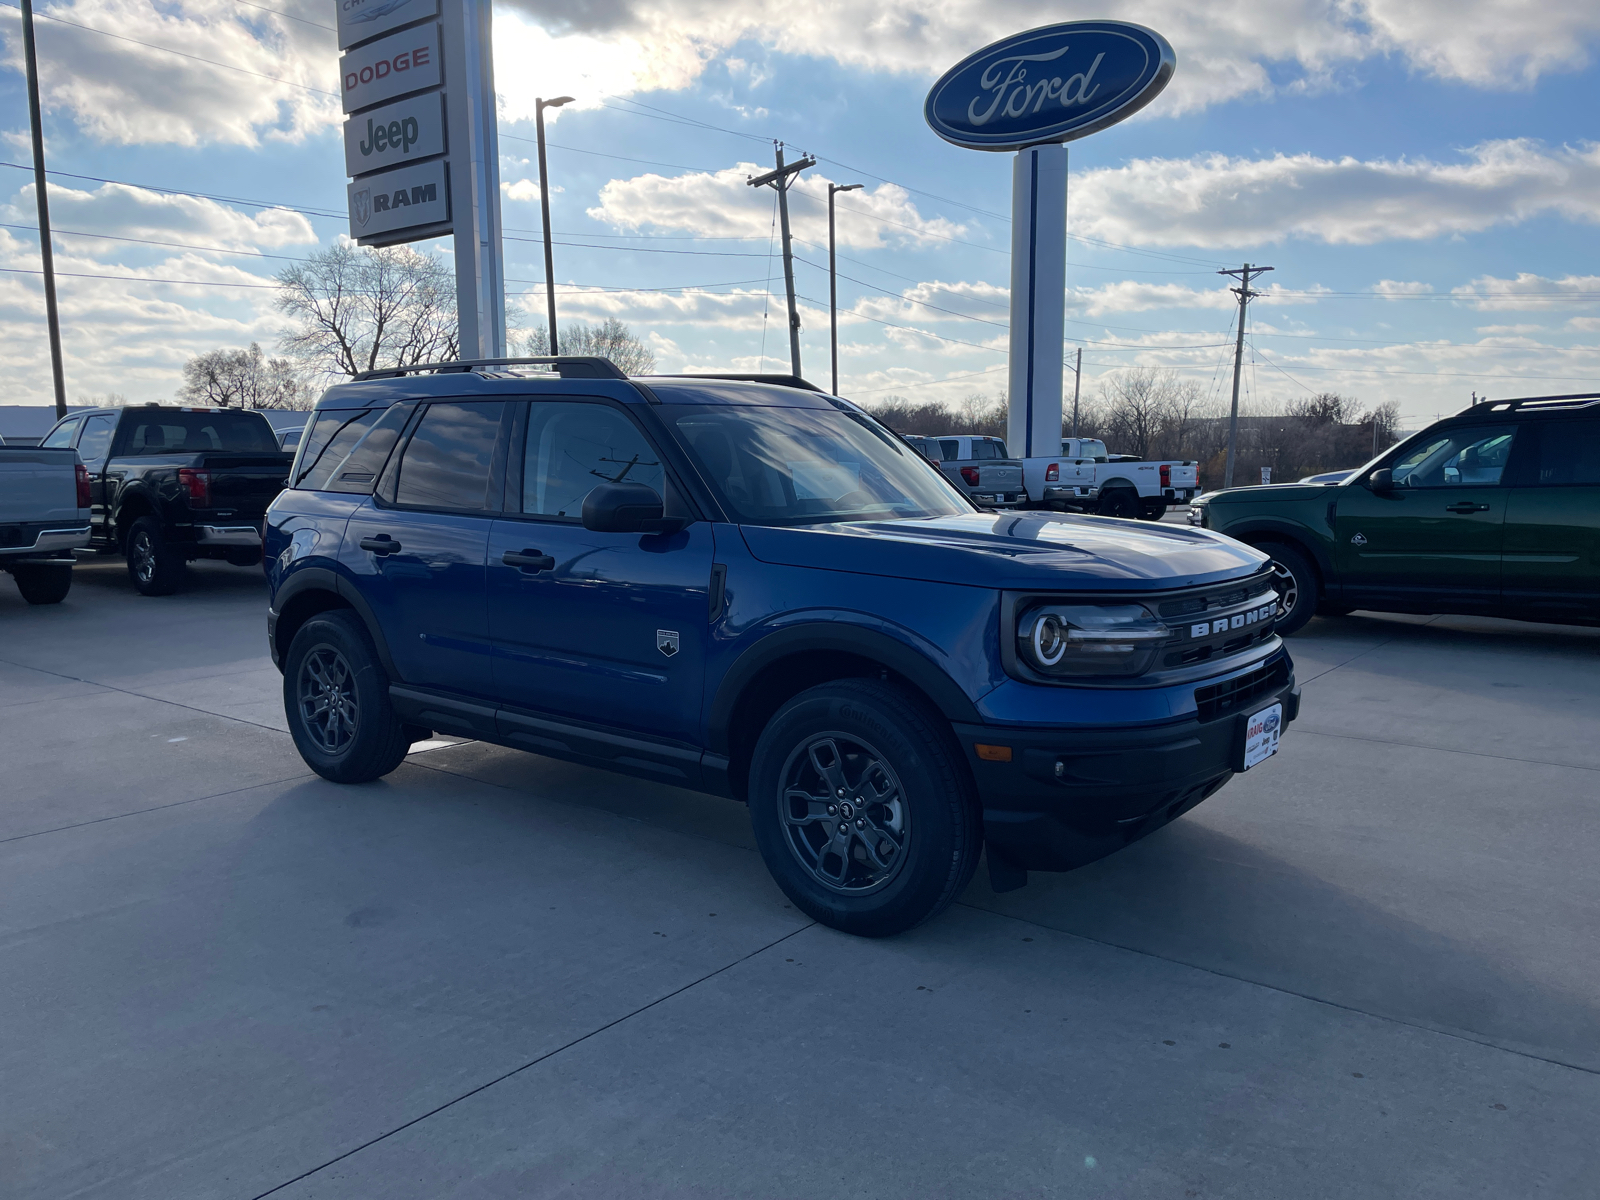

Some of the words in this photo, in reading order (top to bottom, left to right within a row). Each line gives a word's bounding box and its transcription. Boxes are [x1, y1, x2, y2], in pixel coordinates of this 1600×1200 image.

[345, 46, 430, 91] DODGE
[968, 46, 1106, 126] Ford
[359, 116, 419, 156] Jeep
[373, 183, 437, 213] RAM
[1191, 602, 1277, 638] BRONCO
[1247, 722, 1263, 740] KRAIG
